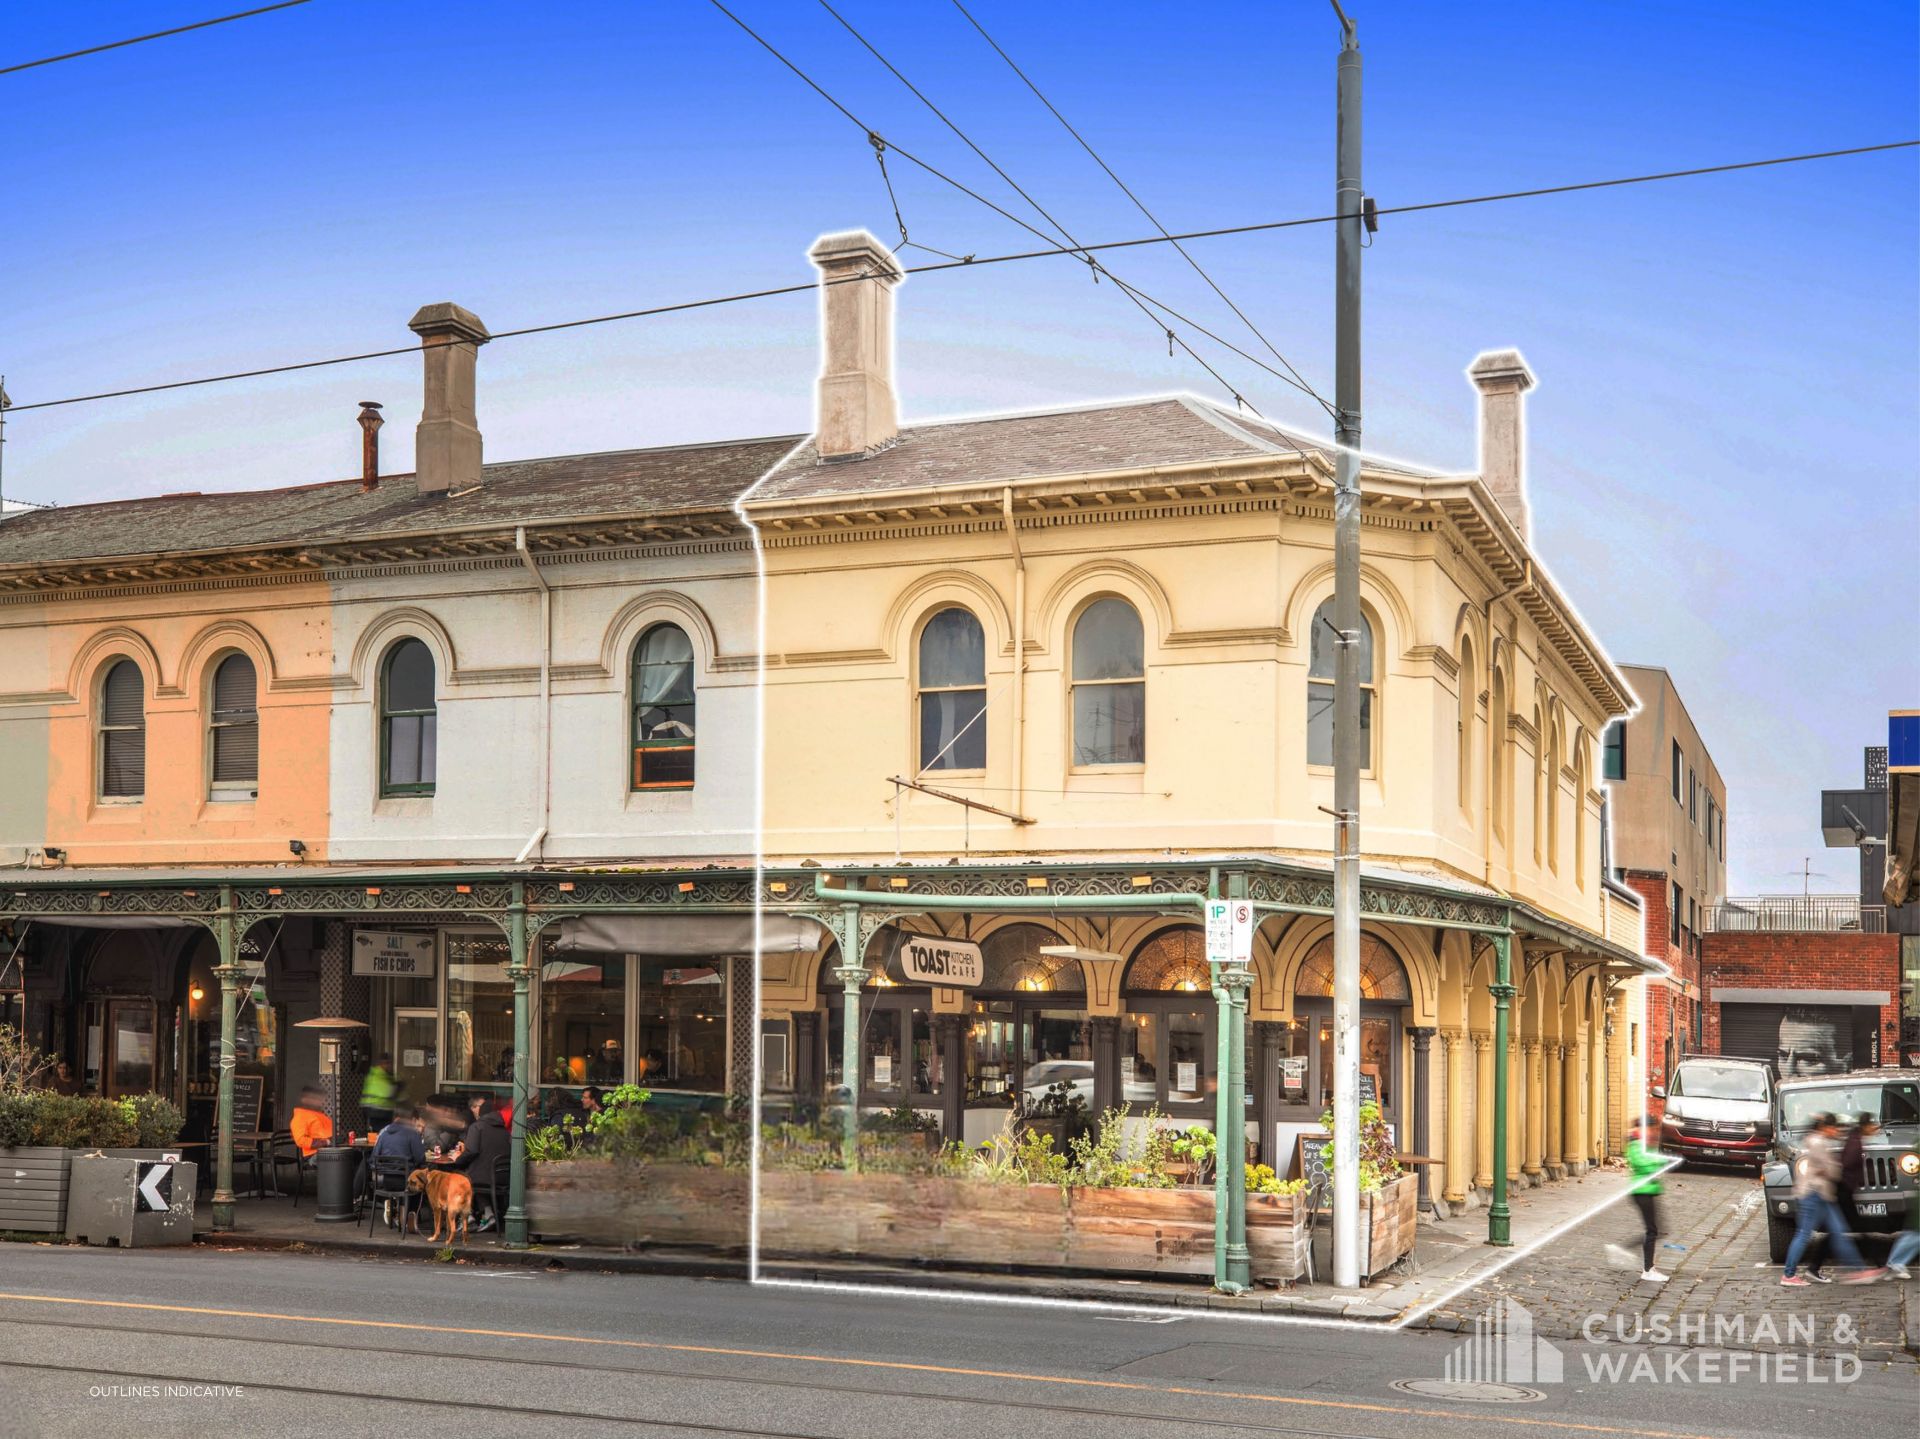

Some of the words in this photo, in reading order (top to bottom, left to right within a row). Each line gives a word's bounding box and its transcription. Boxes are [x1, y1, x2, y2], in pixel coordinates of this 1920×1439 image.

[1211, 906, 1226, 919] 1P
[373, 957, 389, 971] FISH
[396, 958, 416, 972] CHIPS
[910, 945, 951, 976] TOAST
[951, 951, 975, 966] KITCHEN
[952, 965, 976, 978] CAFE
